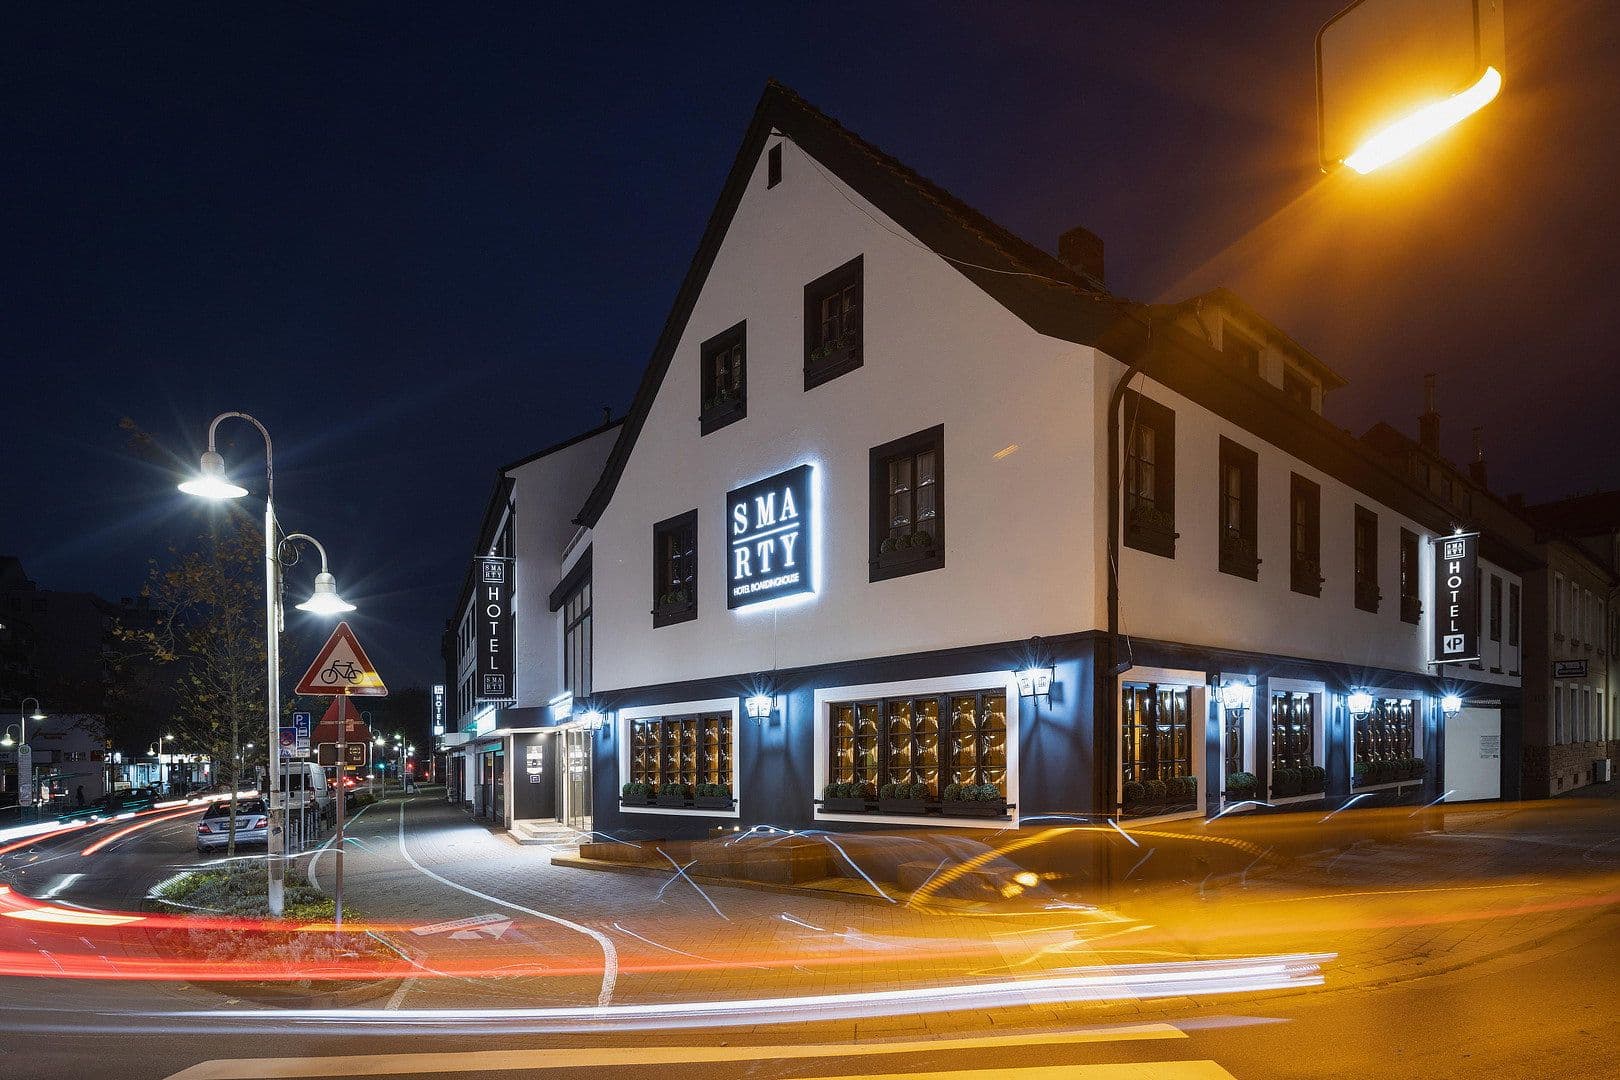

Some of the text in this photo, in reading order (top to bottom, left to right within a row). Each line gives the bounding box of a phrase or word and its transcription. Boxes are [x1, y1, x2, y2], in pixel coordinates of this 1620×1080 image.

[734, 487, 799, 535] SMA
[734, 532, 799, 580] RTY
[734, 585, 750, 596] HOTEL
[1447, 561, 1462, 632] HOTEL
[486, 587, 501, 670] HOTEL
[1453, 638, 1463, 650] P
[295, 714, 303, 725] P
